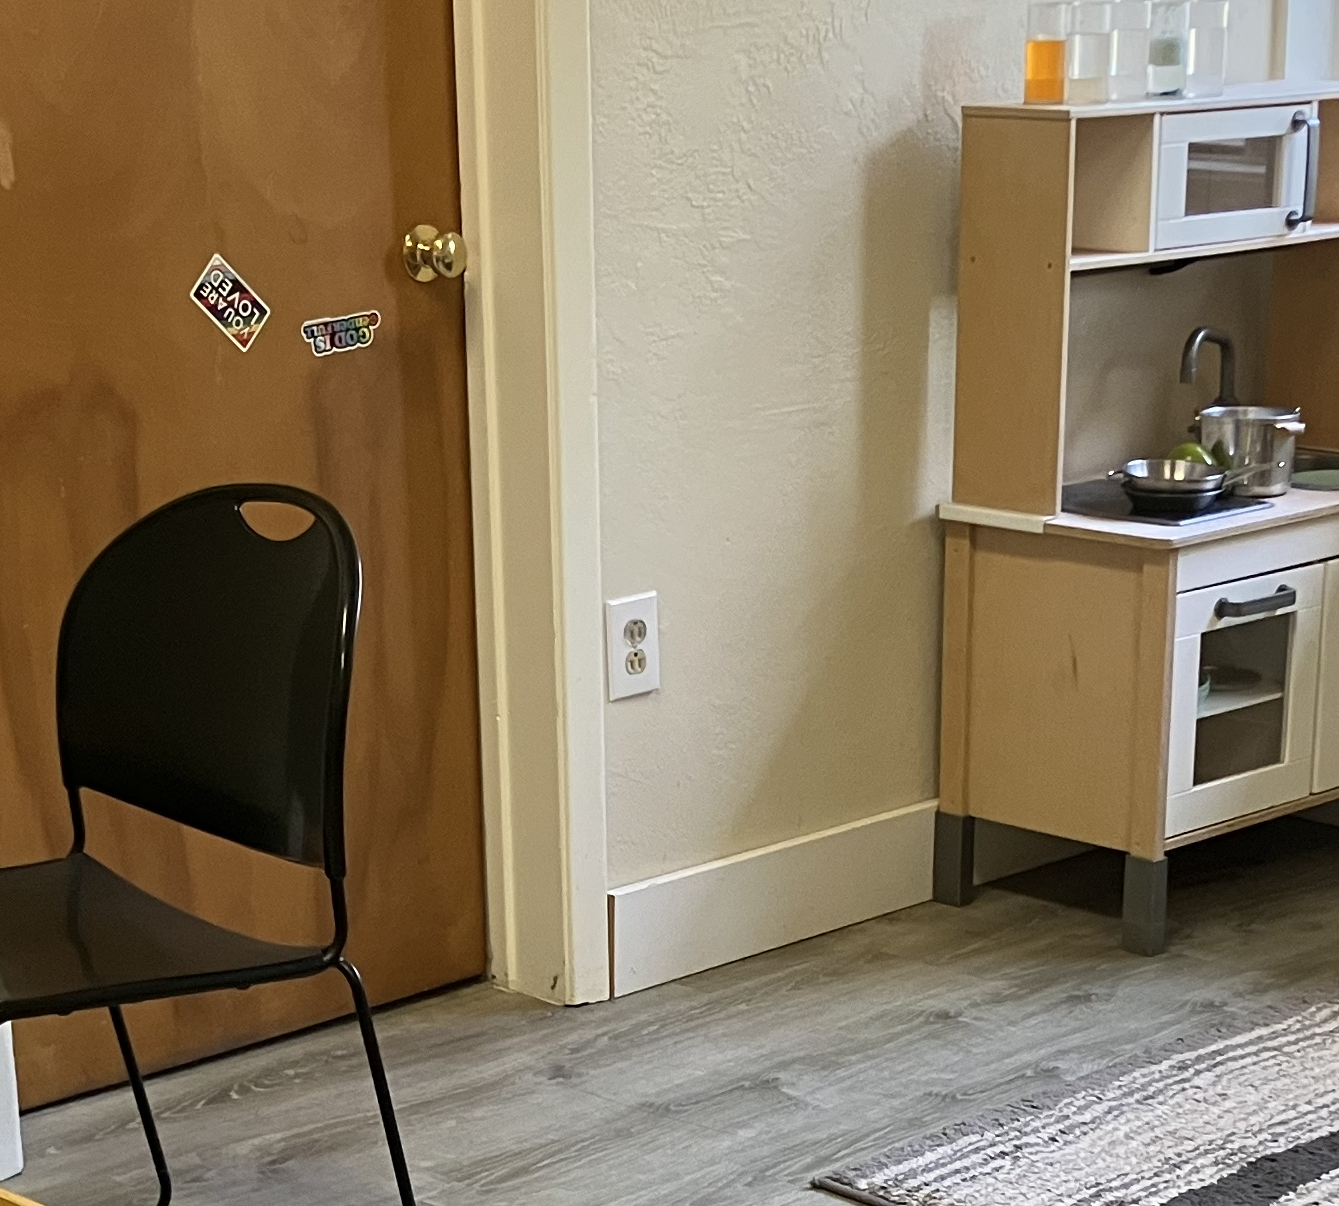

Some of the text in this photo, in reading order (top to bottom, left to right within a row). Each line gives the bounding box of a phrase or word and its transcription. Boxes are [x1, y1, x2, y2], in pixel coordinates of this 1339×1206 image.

[199, 282, 250, 339] YOU ARE
[210, 269, 260, 325] LOVED
[315, 327, 370, 352] GOD IS
